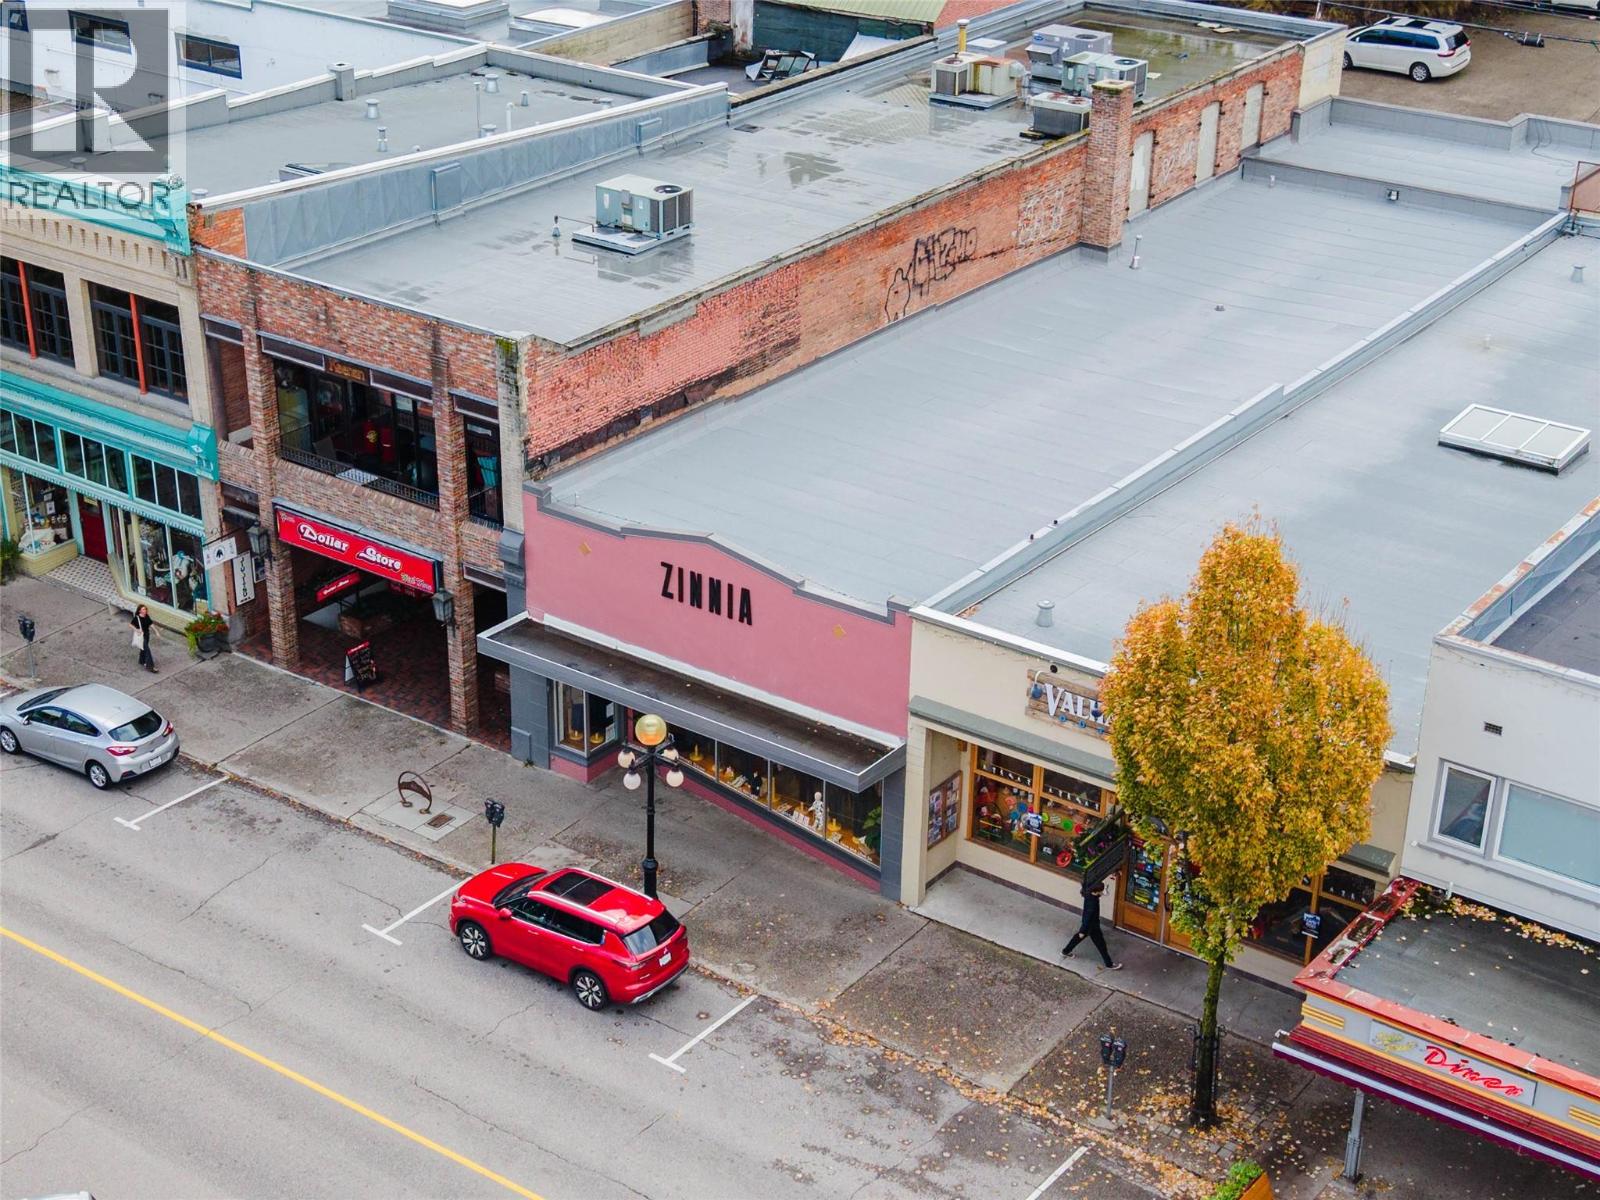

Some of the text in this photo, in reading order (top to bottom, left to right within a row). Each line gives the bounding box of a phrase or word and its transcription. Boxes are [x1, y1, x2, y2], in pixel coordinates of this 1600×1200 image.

[298, 523, 403, 571] Dollar Store
[660, 561, 753, 626] ZINNIA
[1424, 1045, 1524, 1097] Diner
